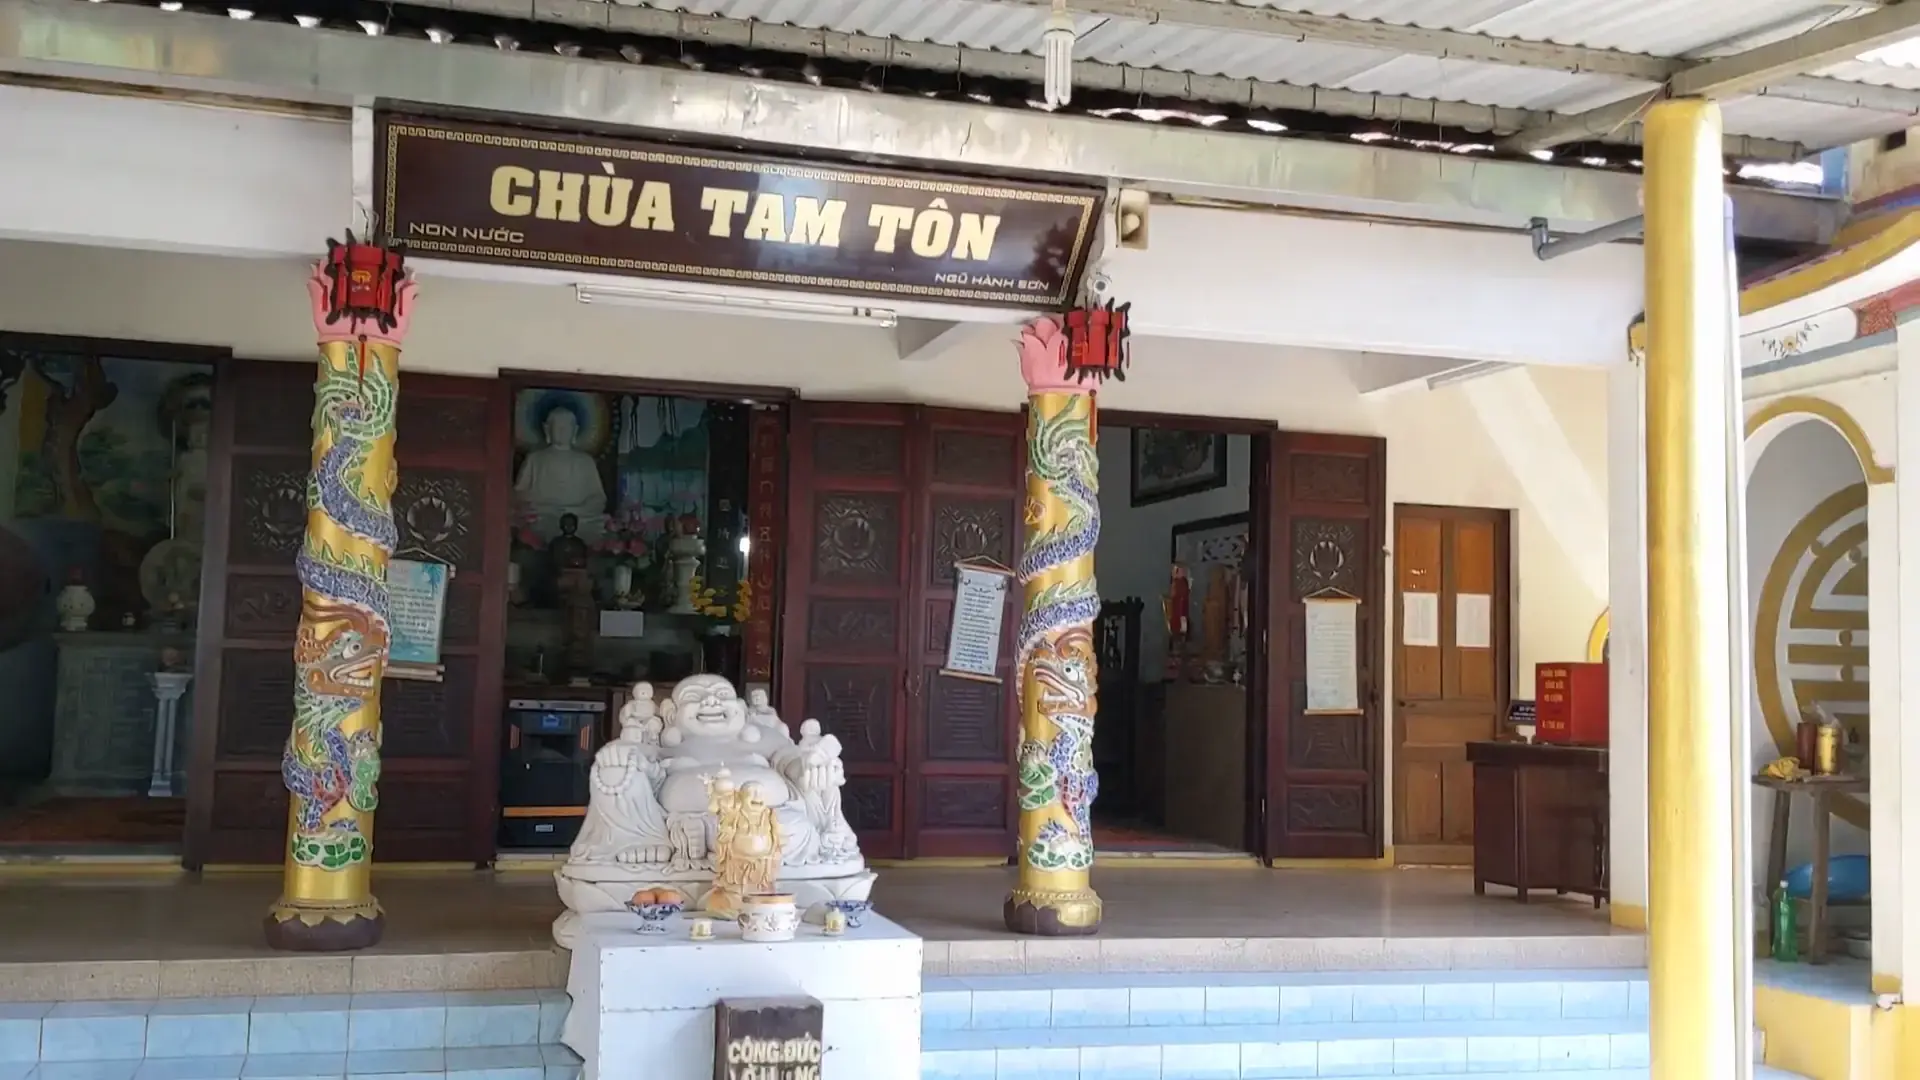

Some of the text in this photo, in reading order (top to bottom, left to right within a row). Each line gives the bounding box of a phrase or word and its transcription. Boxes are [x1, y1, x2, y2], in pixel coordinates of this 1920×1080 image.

[490, 161, 1001, 261] CHÙA TAM TÔN
[409, 222, 524, 243] NON NƯỚC
[971, 274, 1014, 288] HÀNH
[728, 1032, 821, 1064] CÔNG ĐỨC
